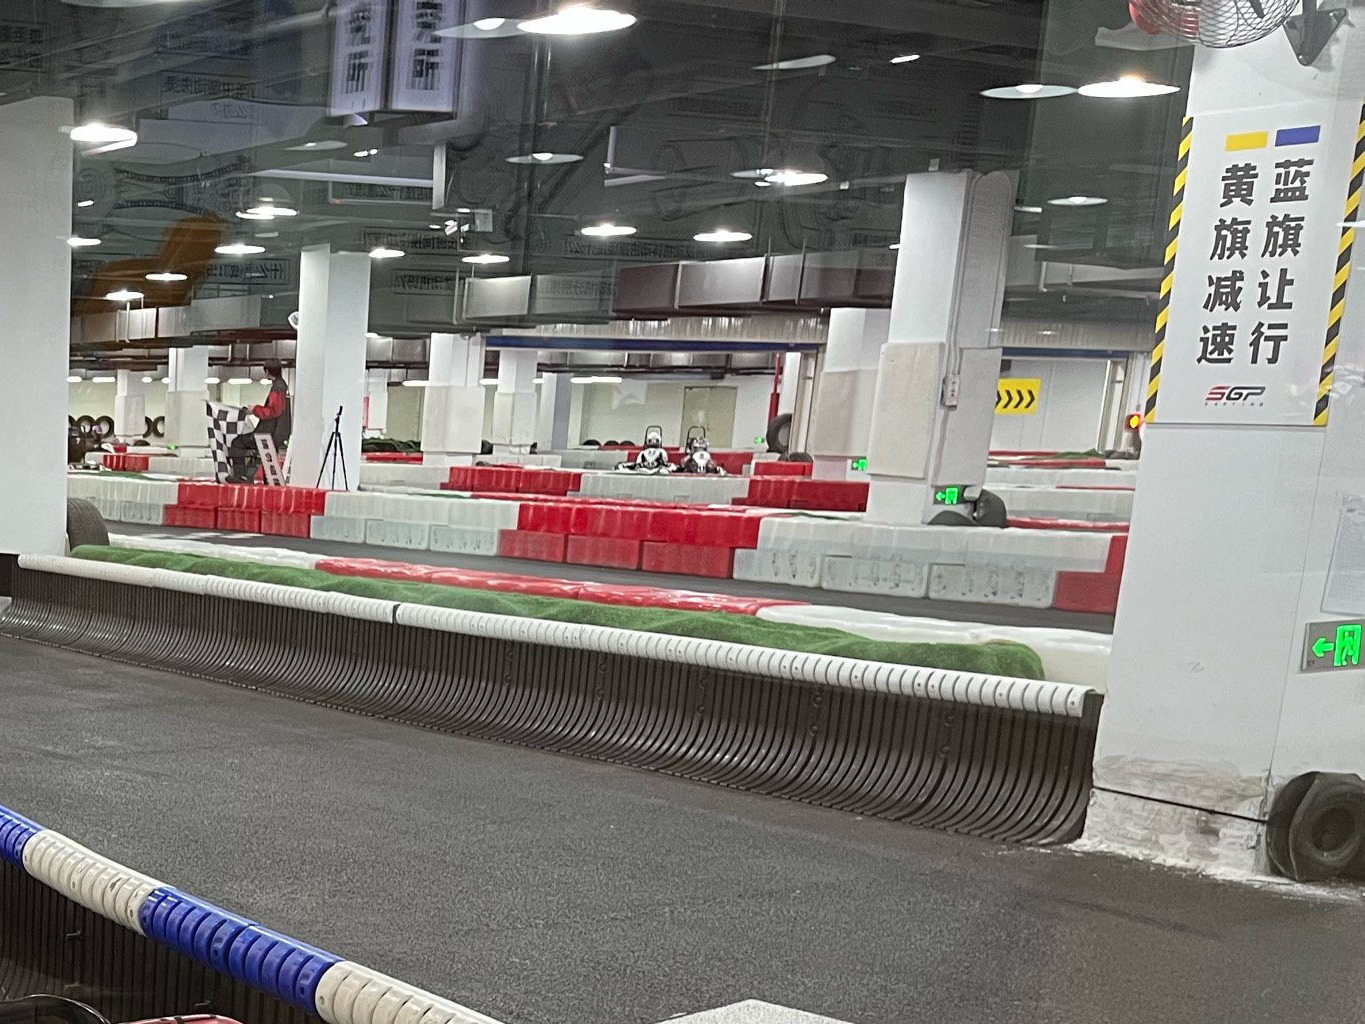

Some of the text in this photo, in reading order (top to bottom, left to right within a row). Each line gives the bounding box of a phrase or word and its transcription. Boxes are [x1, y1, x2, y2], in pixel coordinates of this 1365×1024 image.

[1196, 162, 1259, 365] 黄旗减速
[1248, 158, 1315, 365] 蓝旗让行
[1205, 385, 1266, 401] SGP
